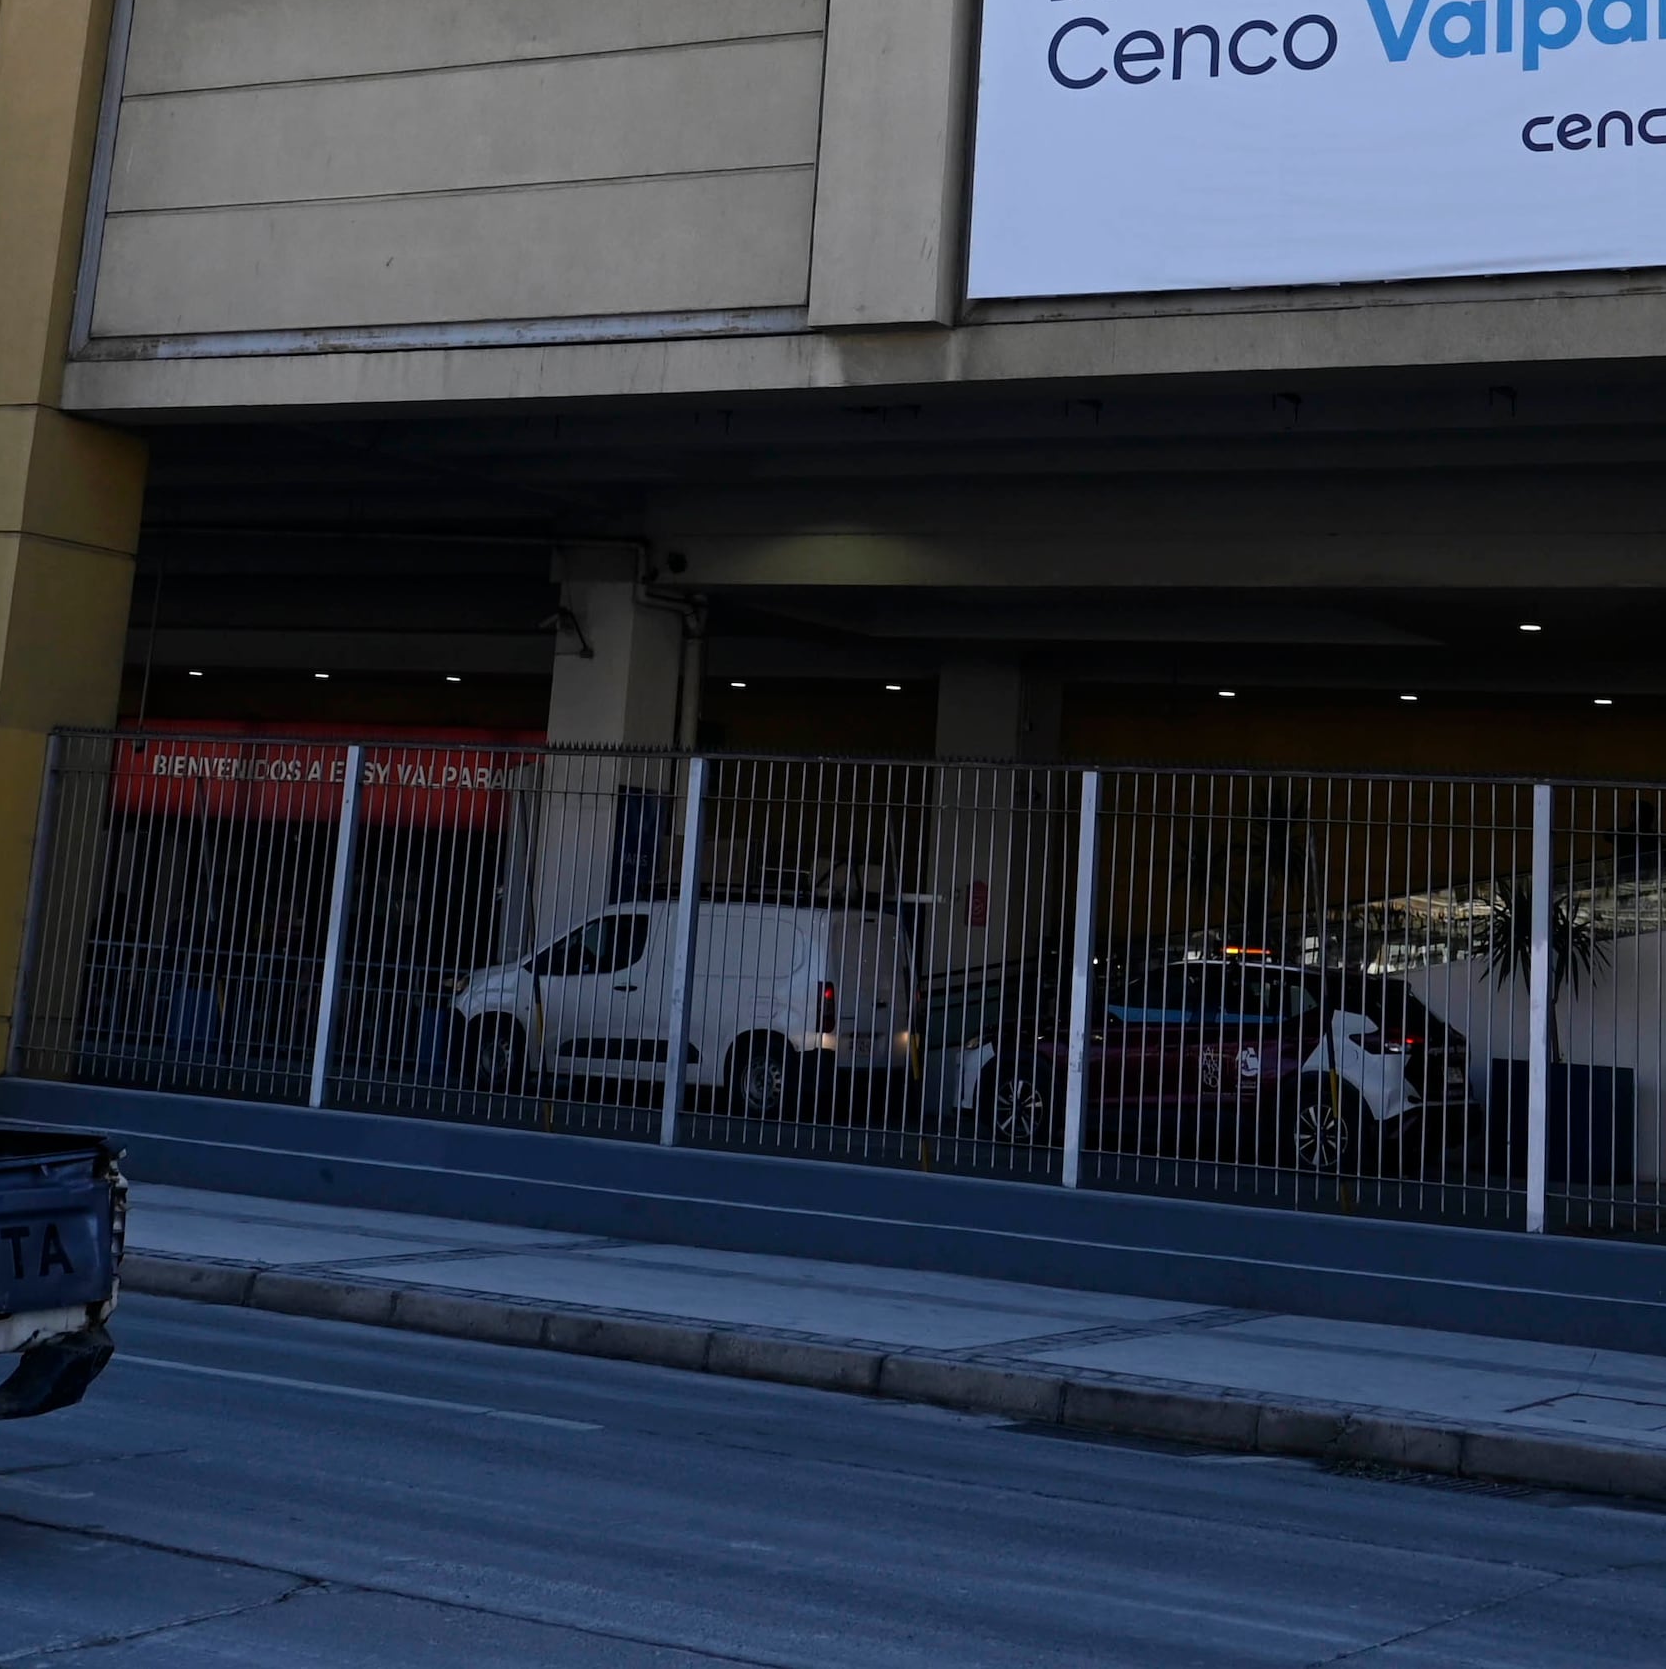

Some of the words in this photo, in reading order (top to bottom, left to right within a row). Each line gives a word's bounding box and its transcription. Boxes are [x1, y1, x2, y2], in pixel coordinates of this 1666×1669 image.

[1047, 13, 1339, 91] Cenco
[152, 753, 302, 782] BIENVENIDOS
[307, 759, 322, 782] A
[329, 759, 391, 786] ESY
